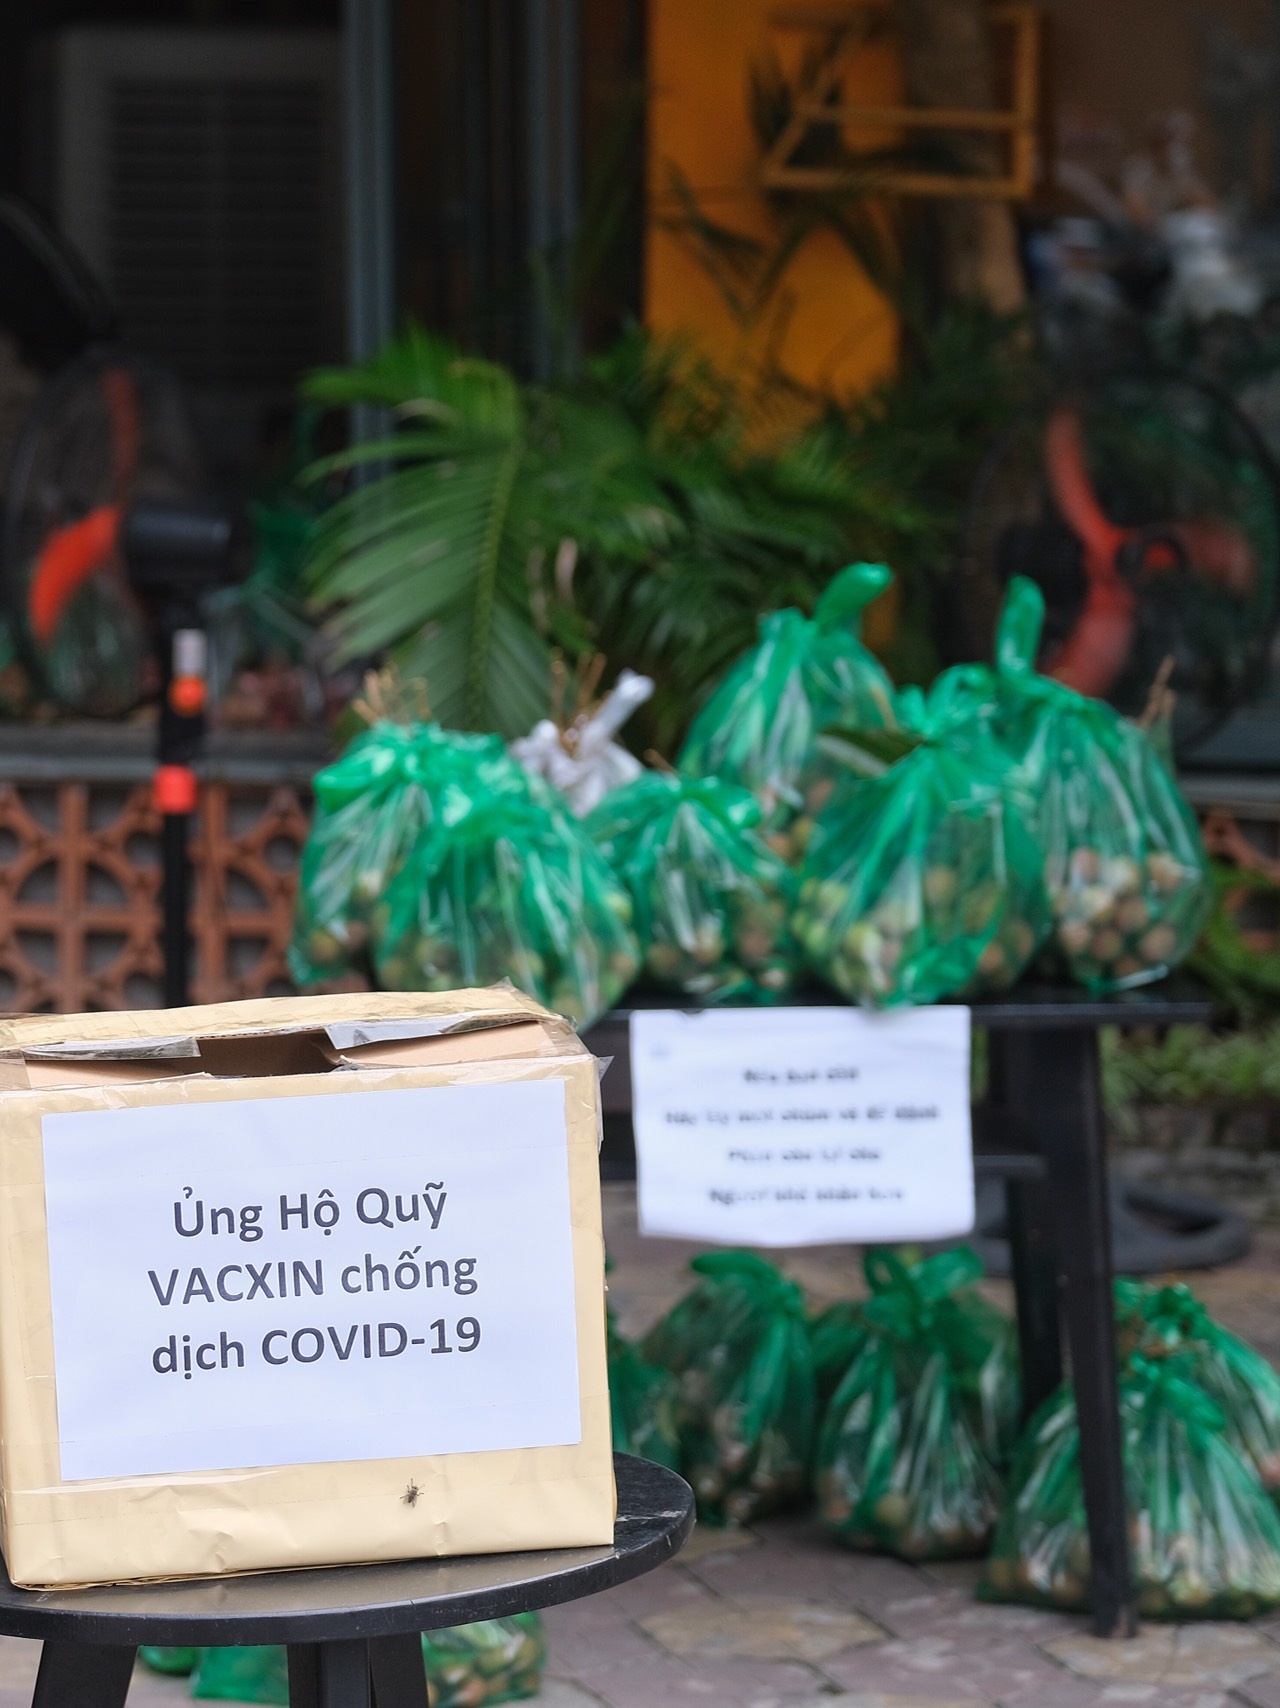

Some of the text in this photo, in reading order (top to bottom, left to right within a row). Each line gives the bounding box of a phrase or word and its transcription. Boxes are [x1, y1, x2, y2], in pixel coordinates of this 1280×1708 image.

[174, 1182, 447, 1242] Ủng Hộ Quỹ
[148, 1246, 477, 1305] VACXIN chống
[153, 1317, 480, 1379] dịch COVID-19
